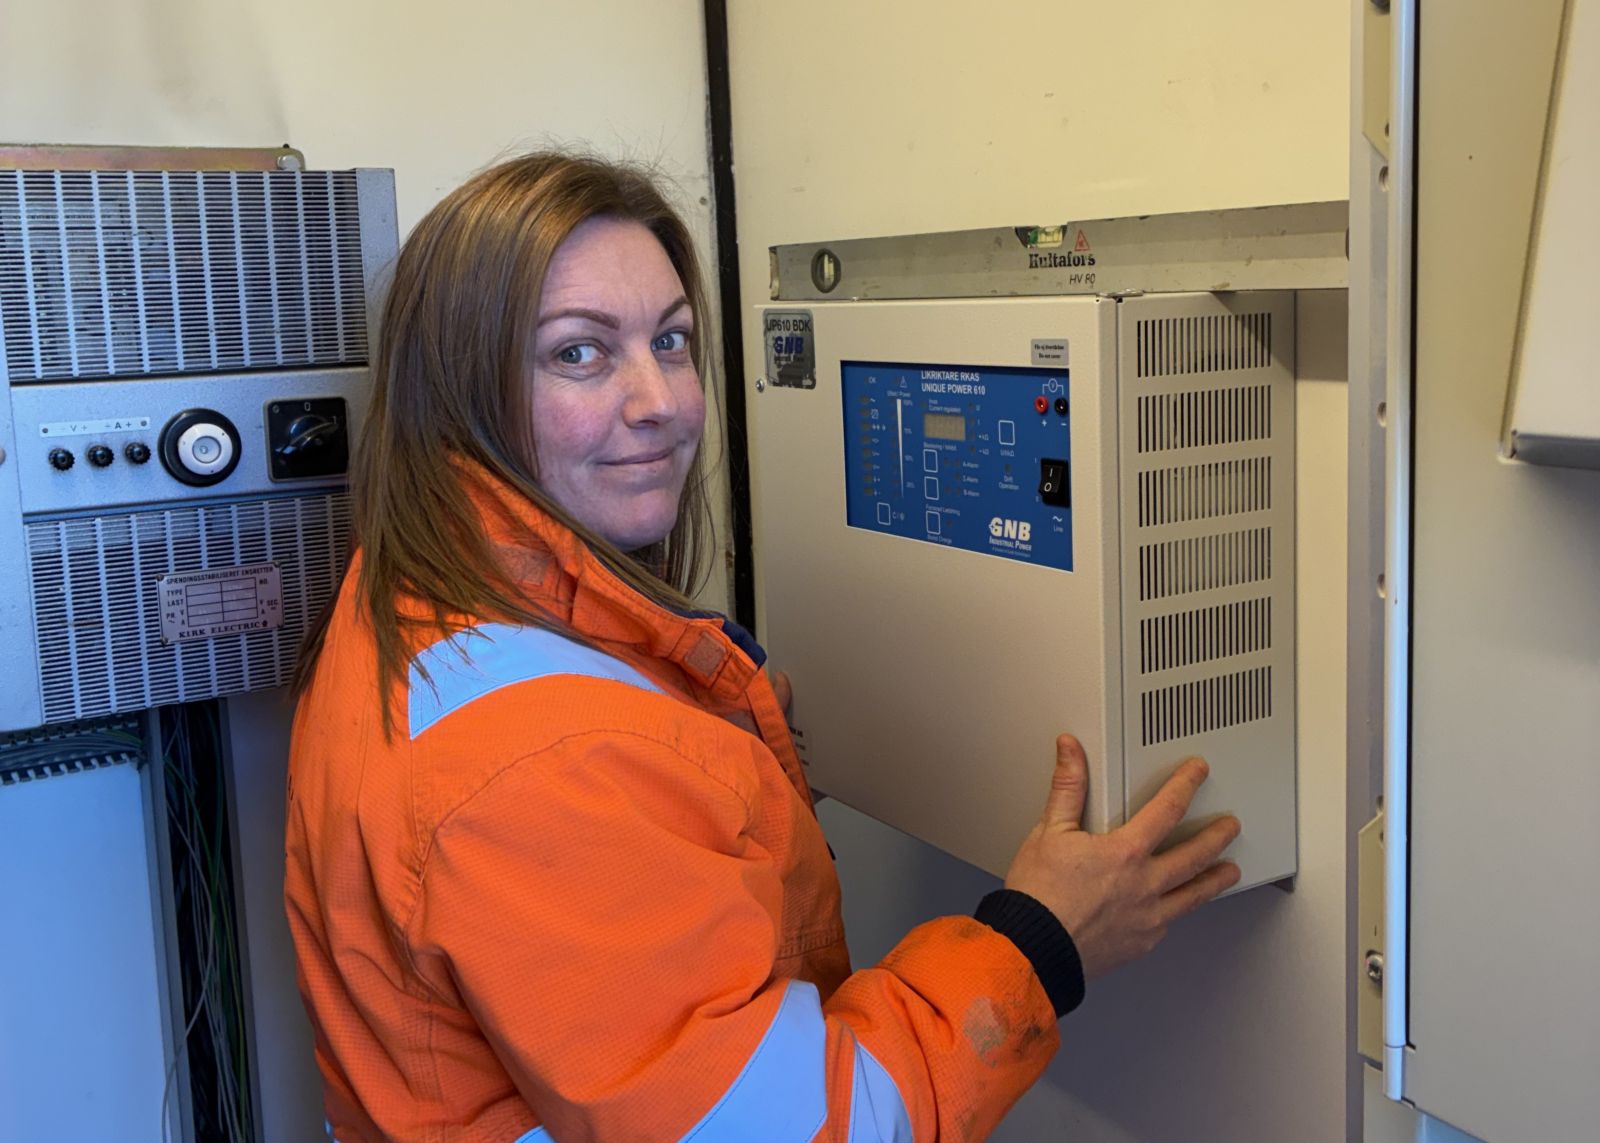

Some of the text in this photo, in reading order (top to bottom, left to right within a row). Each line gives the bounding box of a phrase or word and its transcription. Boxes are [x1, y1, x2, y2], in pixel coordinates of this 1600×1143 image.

[767, 319, 812, 333] UP610 BDK
[960, 372, 981, 383] RKAS
[921, 382, 986, 396] UNIQUE POWER 610
[988, 517, 1031, 541] GNB
[166, 589, 183, 597] TYPE
[179, 620, 261, 639] KIRK ELECTRIC
